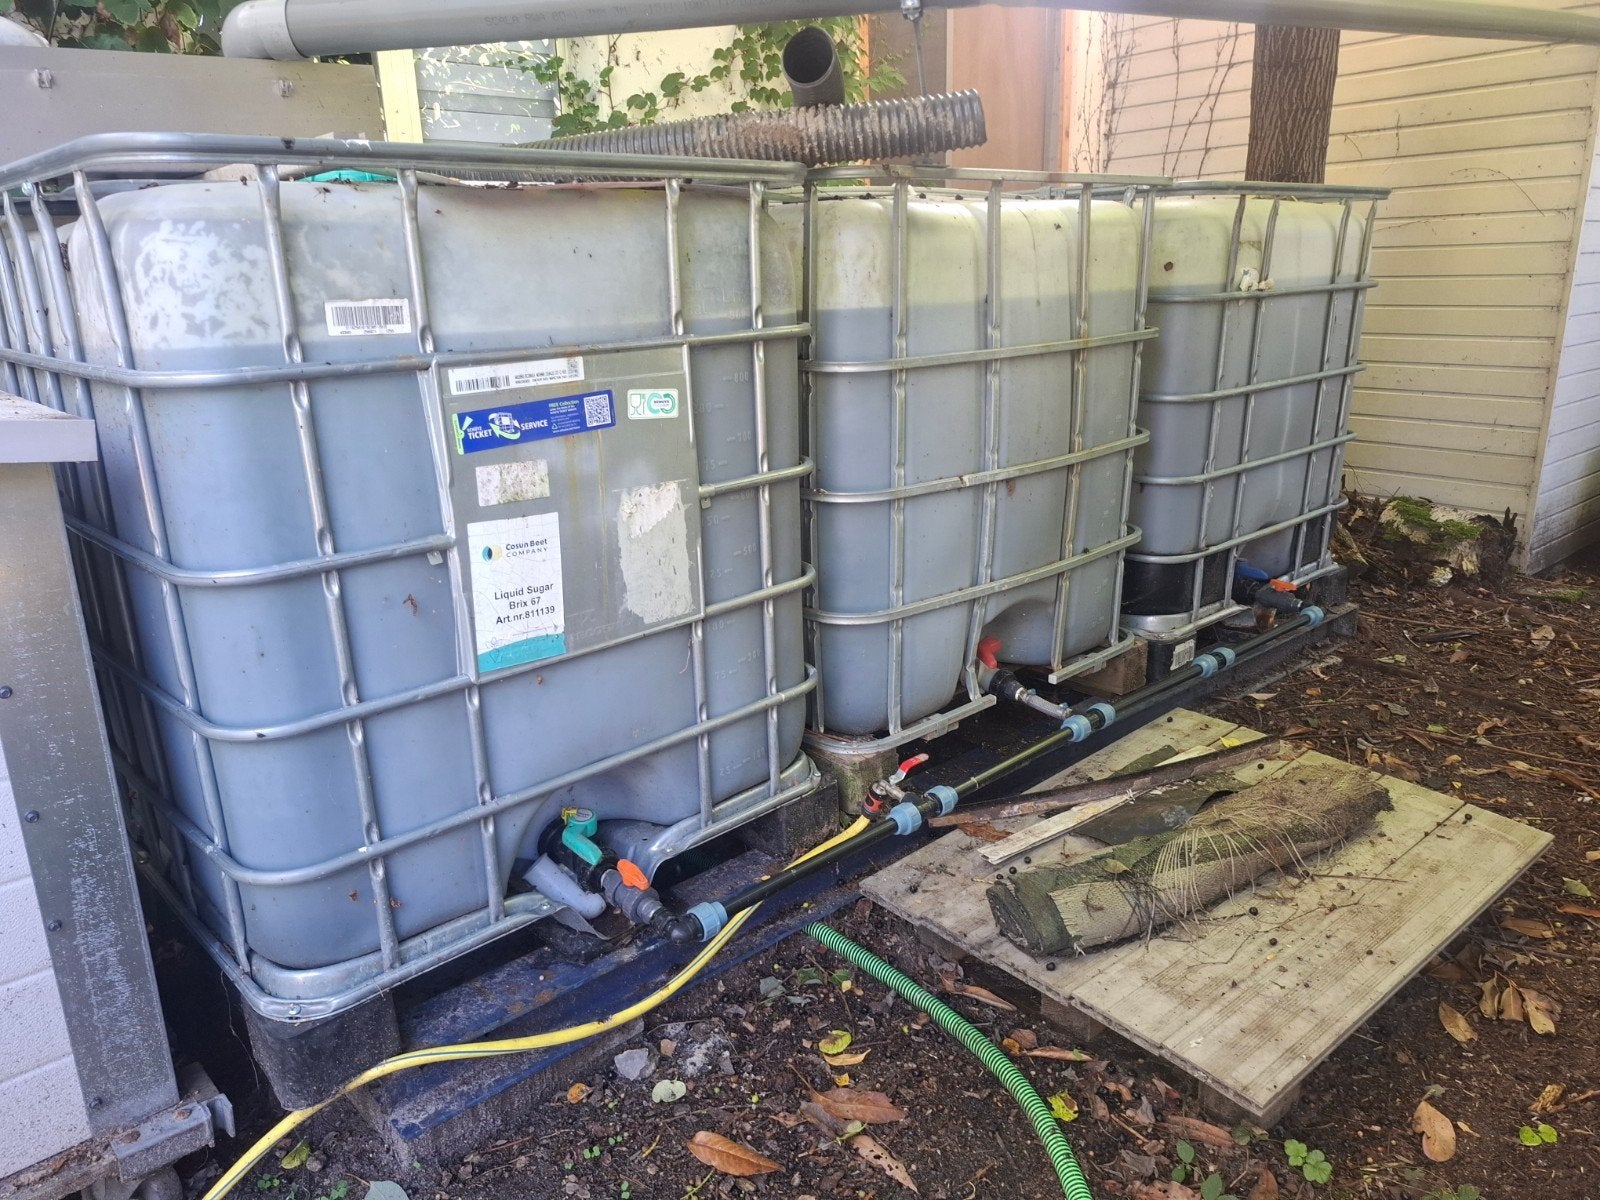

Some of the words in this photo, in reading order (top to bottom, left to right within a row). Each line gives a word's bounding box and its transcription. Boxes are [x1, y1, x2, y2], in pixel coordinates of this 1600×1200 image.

[520, 419, 549, 431] SERVICE
[466, 428, 493, 440] TICKET
[506, 542, 529, 551] Cosun
[530, 538, 548, 547] Beet
[506, 547, 548, 558] COMPANY
[494, 588, 524, 600] Liquid
[526, 583, 554, 596] Sugar
[509, 599, 529, 610] Brix
[531, 597, 541, 606] 67
[496, 605, 555, 625] Art.nr.811139
